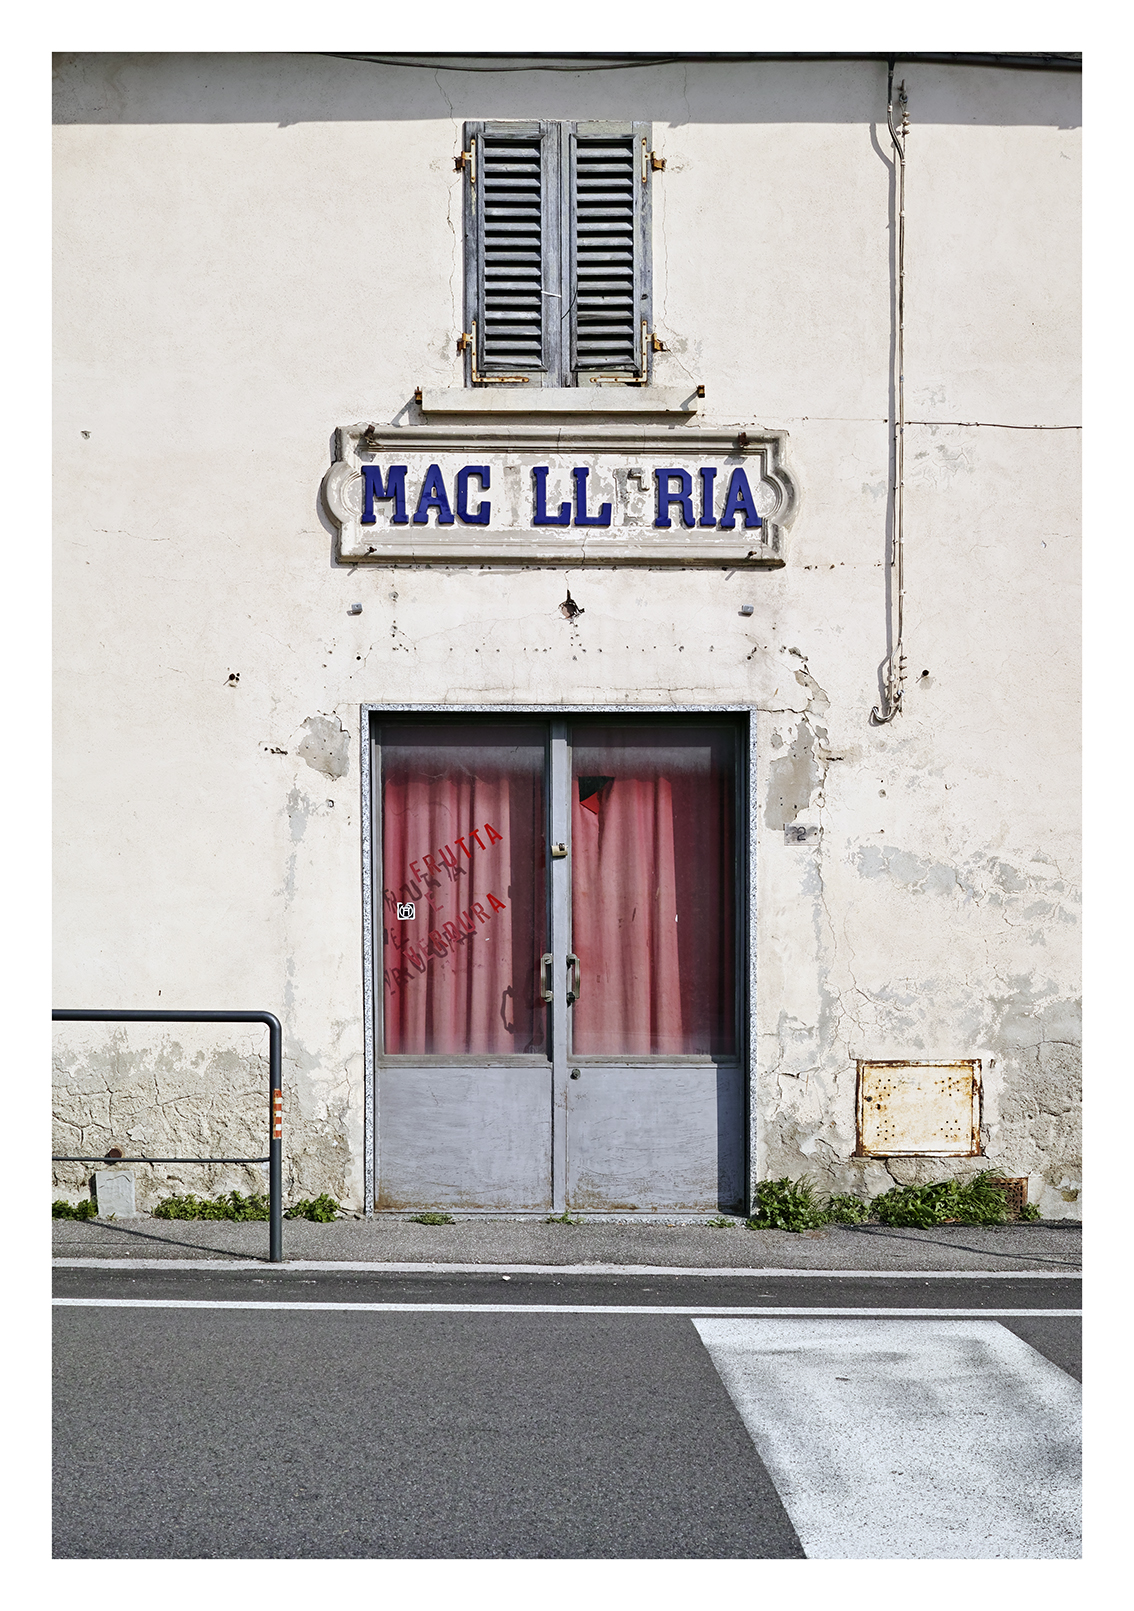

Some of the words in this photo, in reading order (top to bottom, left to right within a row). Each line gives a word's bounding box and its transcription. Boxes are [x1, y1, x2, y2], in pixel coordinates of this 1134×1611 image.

[409, 823, 503, 883] FRUTTA
[796, 826, 807, 841] 2
[424, 890, 444, 912] E
[402, 893, 507, 967] VERDURA
